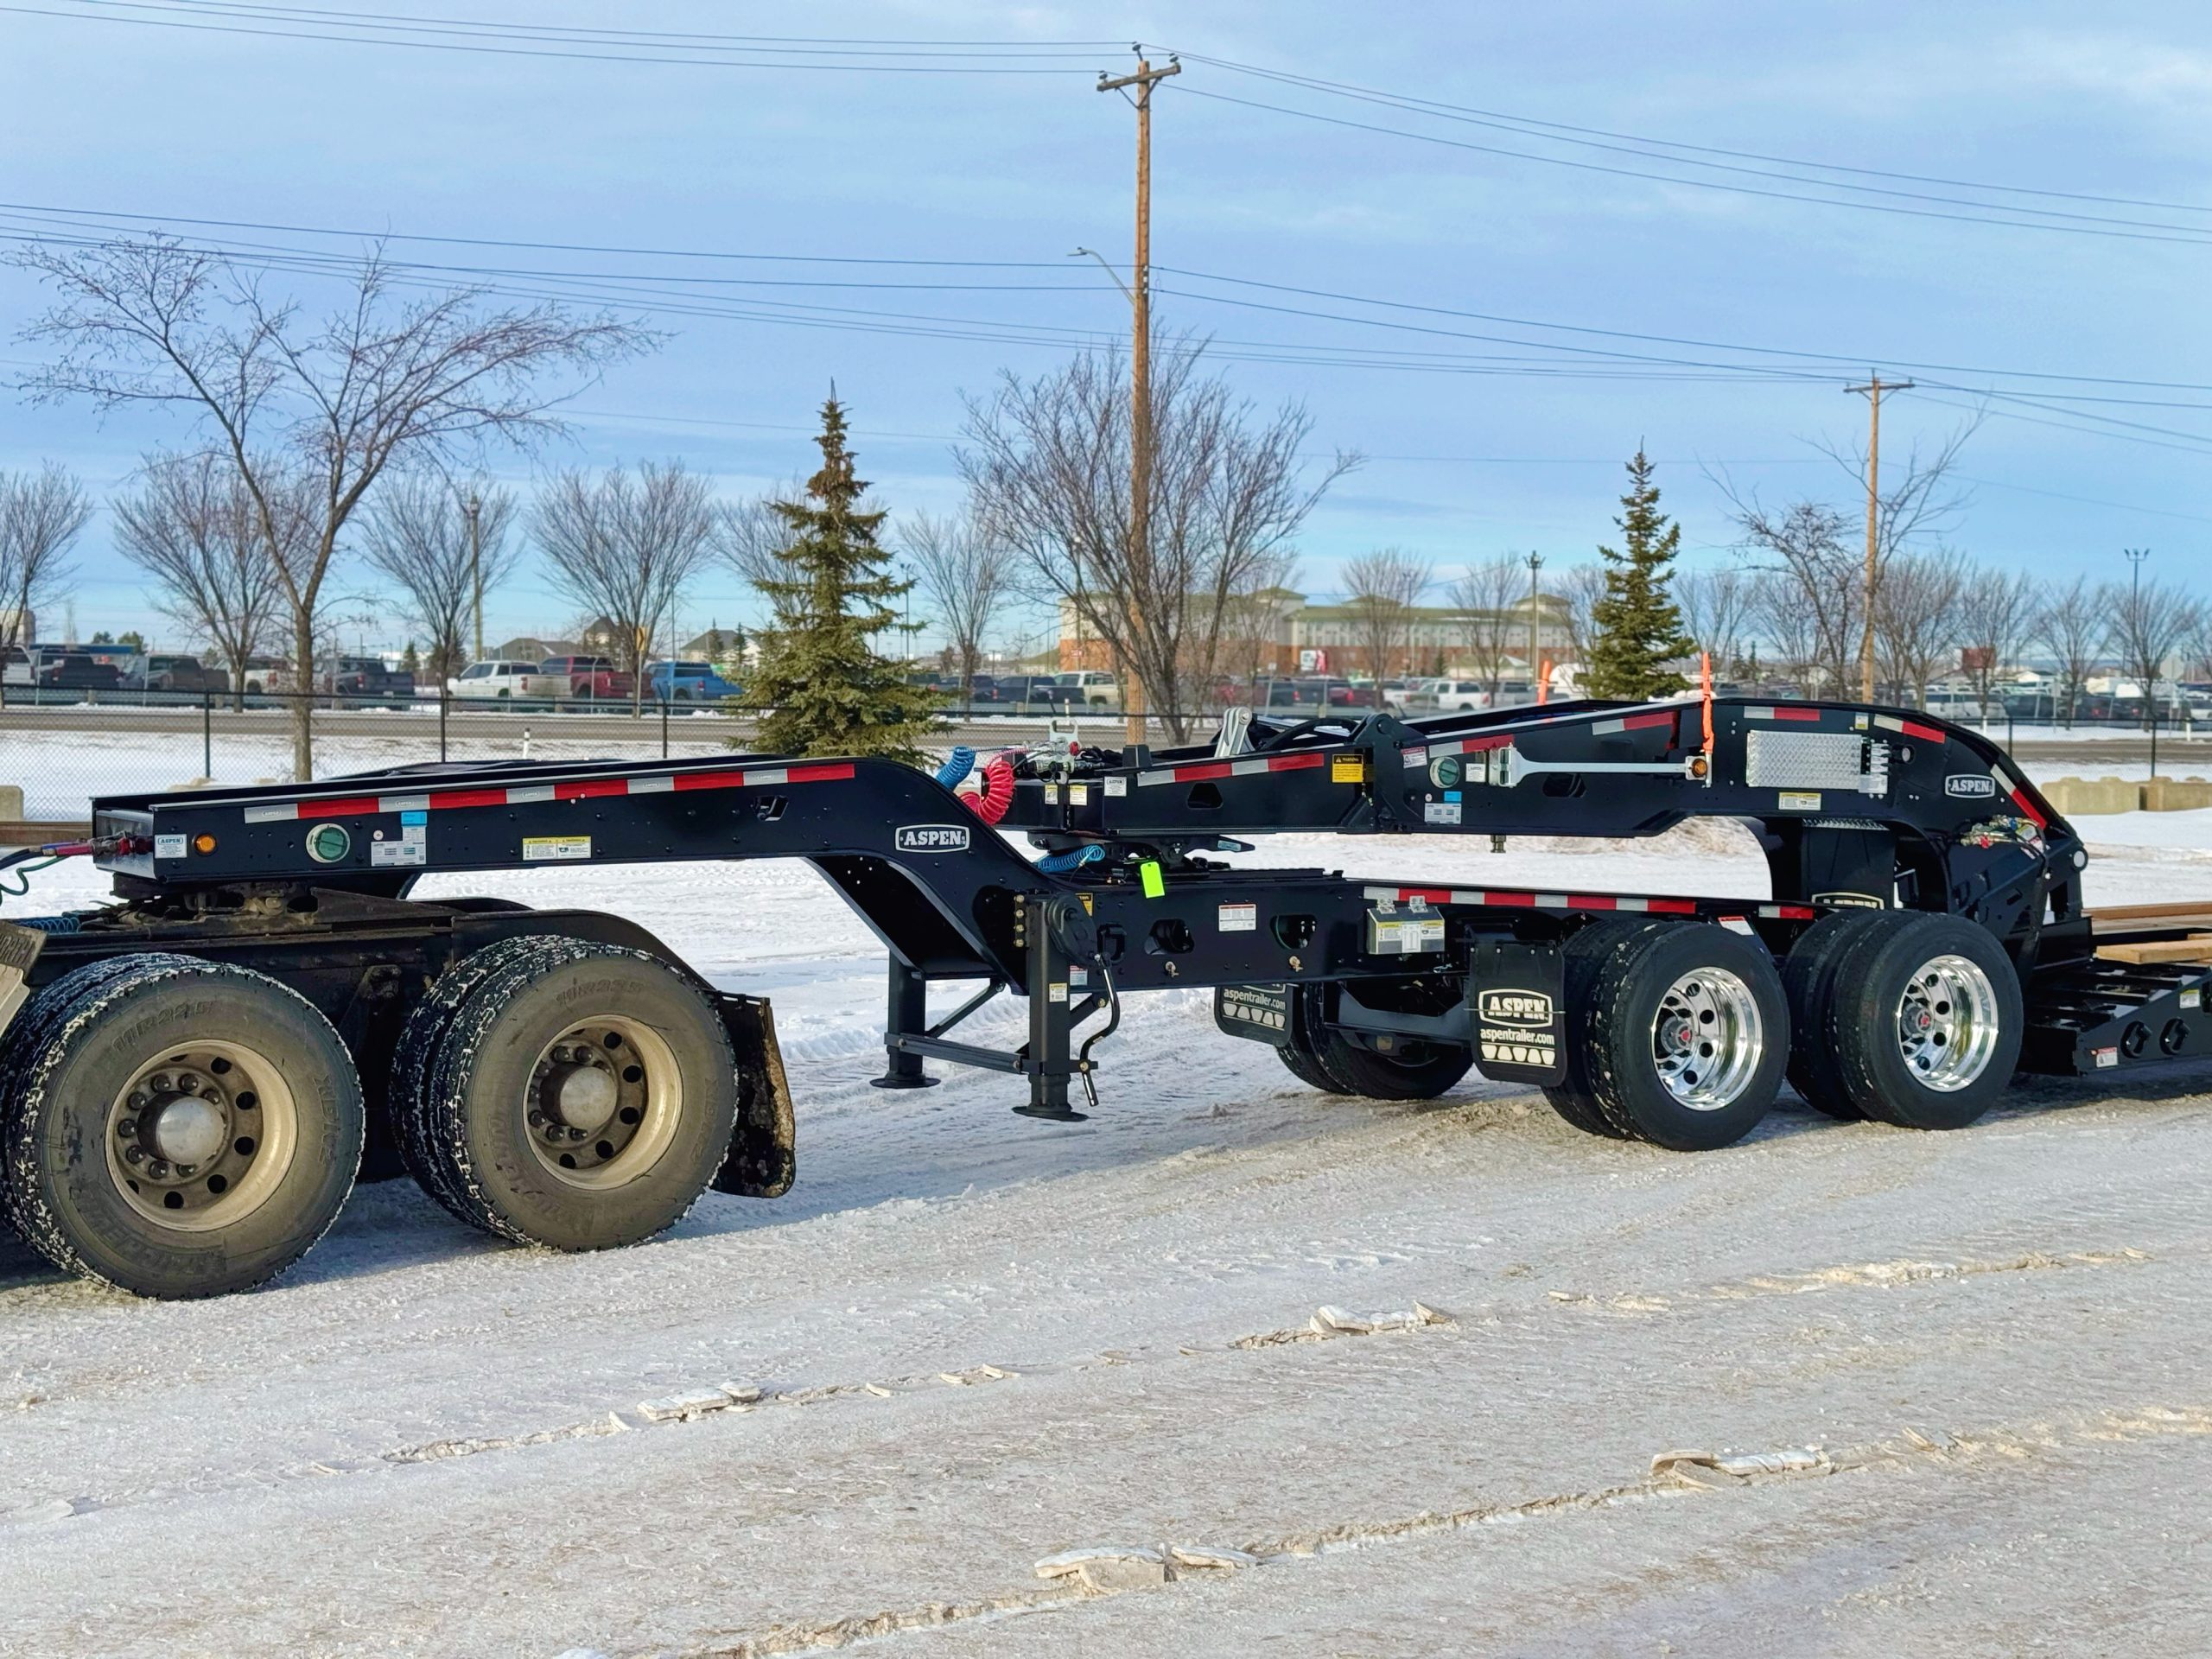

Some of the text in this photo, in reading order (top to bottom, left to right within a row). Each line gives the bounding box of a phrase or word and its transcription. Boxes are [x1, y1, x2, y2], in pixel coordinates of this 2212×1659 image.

[1950, 779, 1990, 792] ASPEN
[903, 830, 963, 846] ASPEN
[1224, 988, 1286, 1010] aspentrailer.com
[1487, 995, 1546, 1020] ASPEN
[1480, 1028, 1555, 1046] aspentrailer.com
